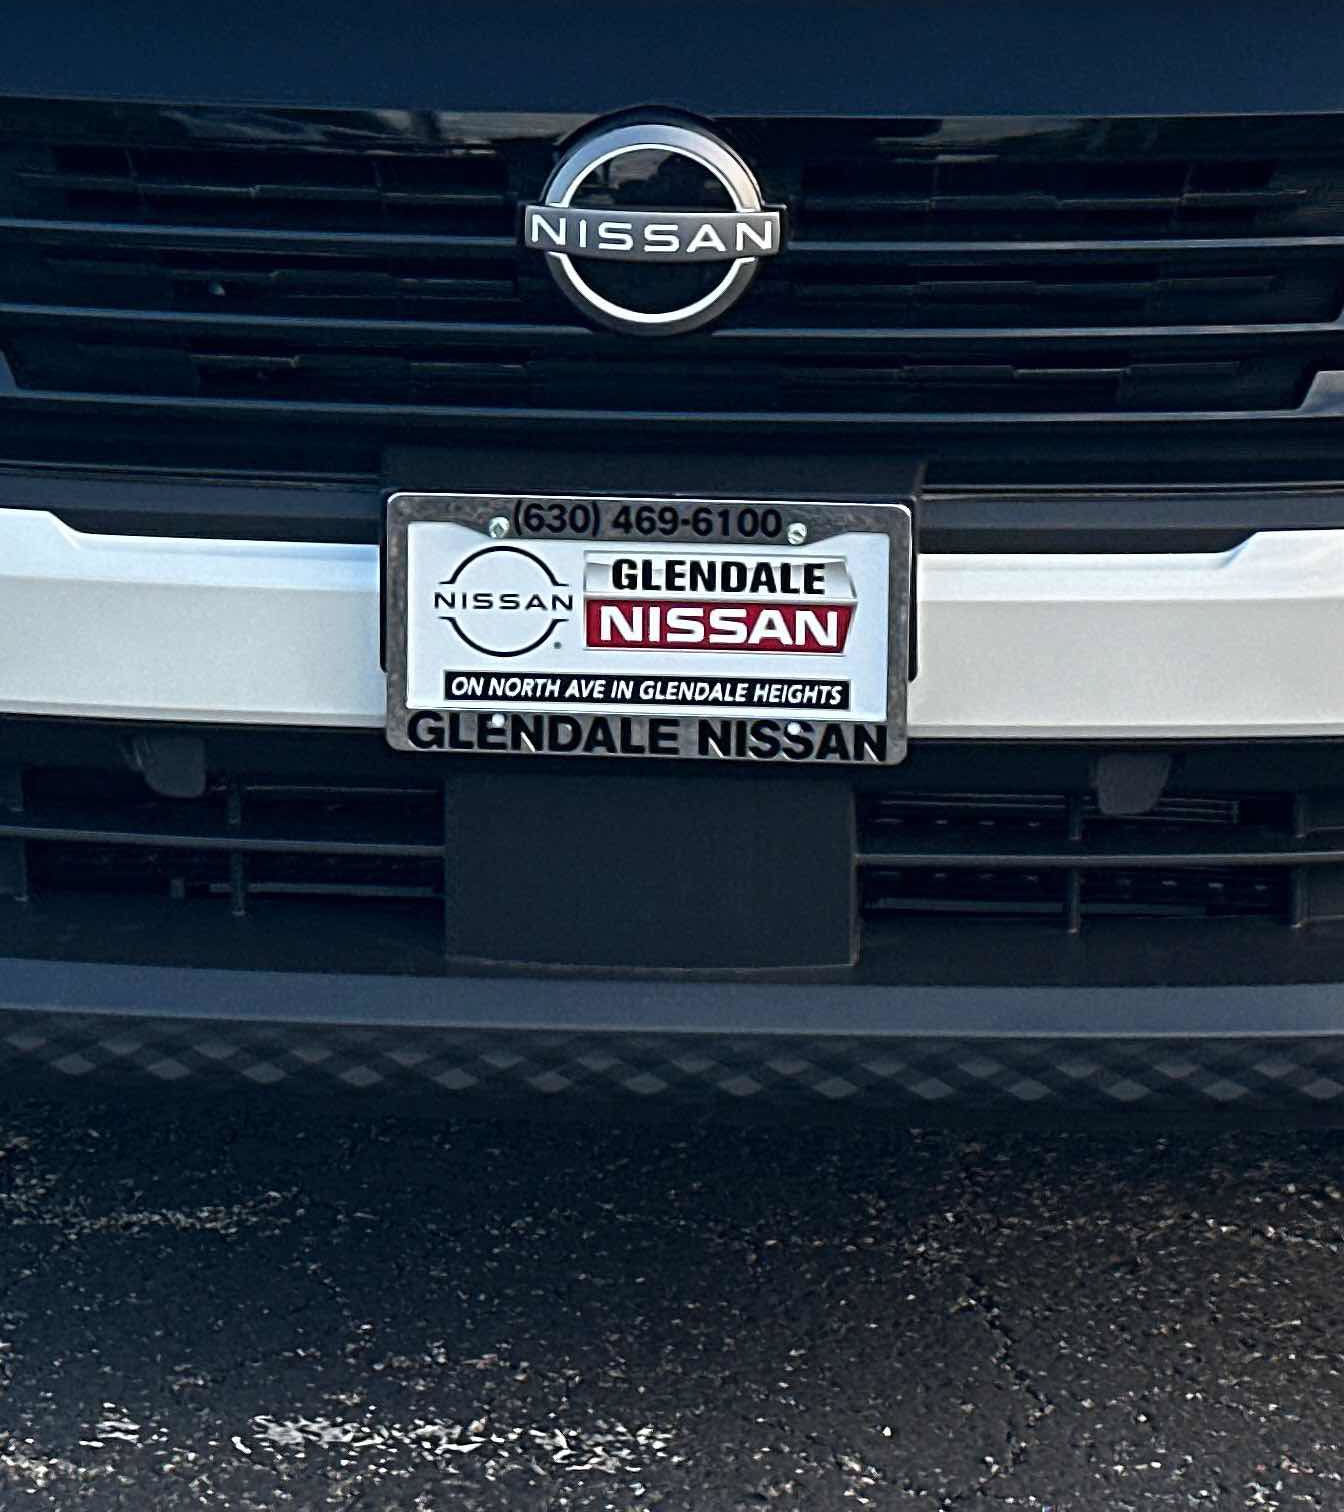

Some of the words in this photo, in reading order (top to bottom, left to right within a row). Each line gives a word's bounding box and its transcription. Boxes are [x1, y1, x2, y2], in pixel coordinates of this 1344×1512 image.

[531, 214, 772, 252] NISSAN
[514, 500, 600, 536] (630)
[612, 505, 783, 538] 469-6100
[612, 558, 825, 595] GLENDALE
[434, 591, 573, 611] NISSAN
[600, 605, 838, 647] NISSAN
[451, 676, 484, 697] ON
[488, 677, 561, 698] NORTH
[565, 679, 606, 699] AVE
[610, 680, 634, 700] IN
[639, 680, 749, 703] GLENDALE
[753, 683, 842, 705] HEIGHTS
[408, 710, 680, 756] GLENDALE
[698, 718, 887, 762] NISSAN
